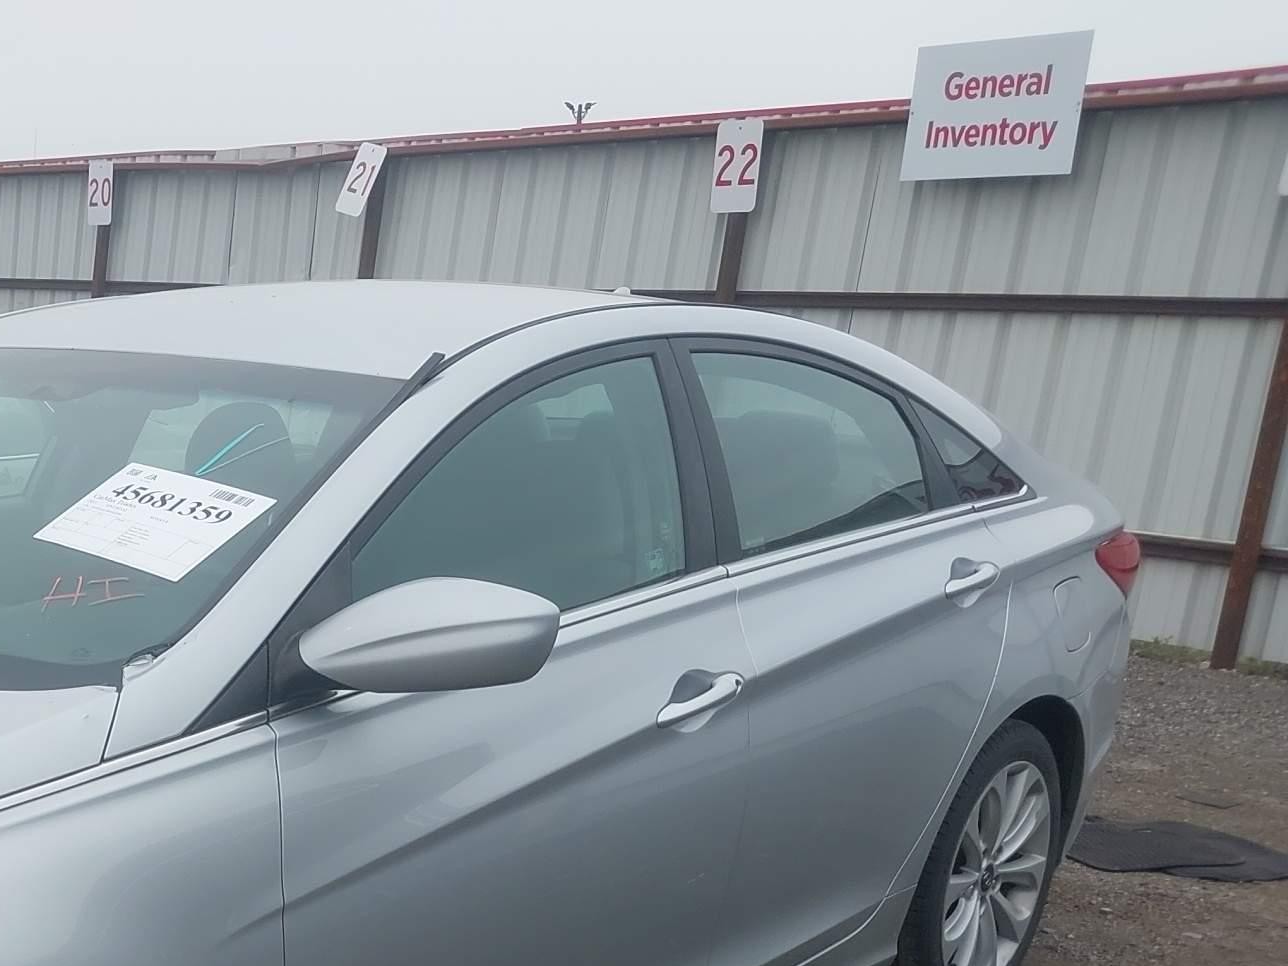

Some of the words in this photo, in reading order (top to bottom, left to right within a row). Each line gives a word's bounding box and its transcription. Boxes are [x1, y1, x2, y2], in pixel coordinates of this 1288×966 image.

[944, 64, 1054, 101] General
[925, 118, 1058, 150] Inventory
[347, 161, 377, 196] 21
[715, 143, 758, 187] 22
[89, 177, 111, 208] 20
[112, 484, 233, 523] 45681359
